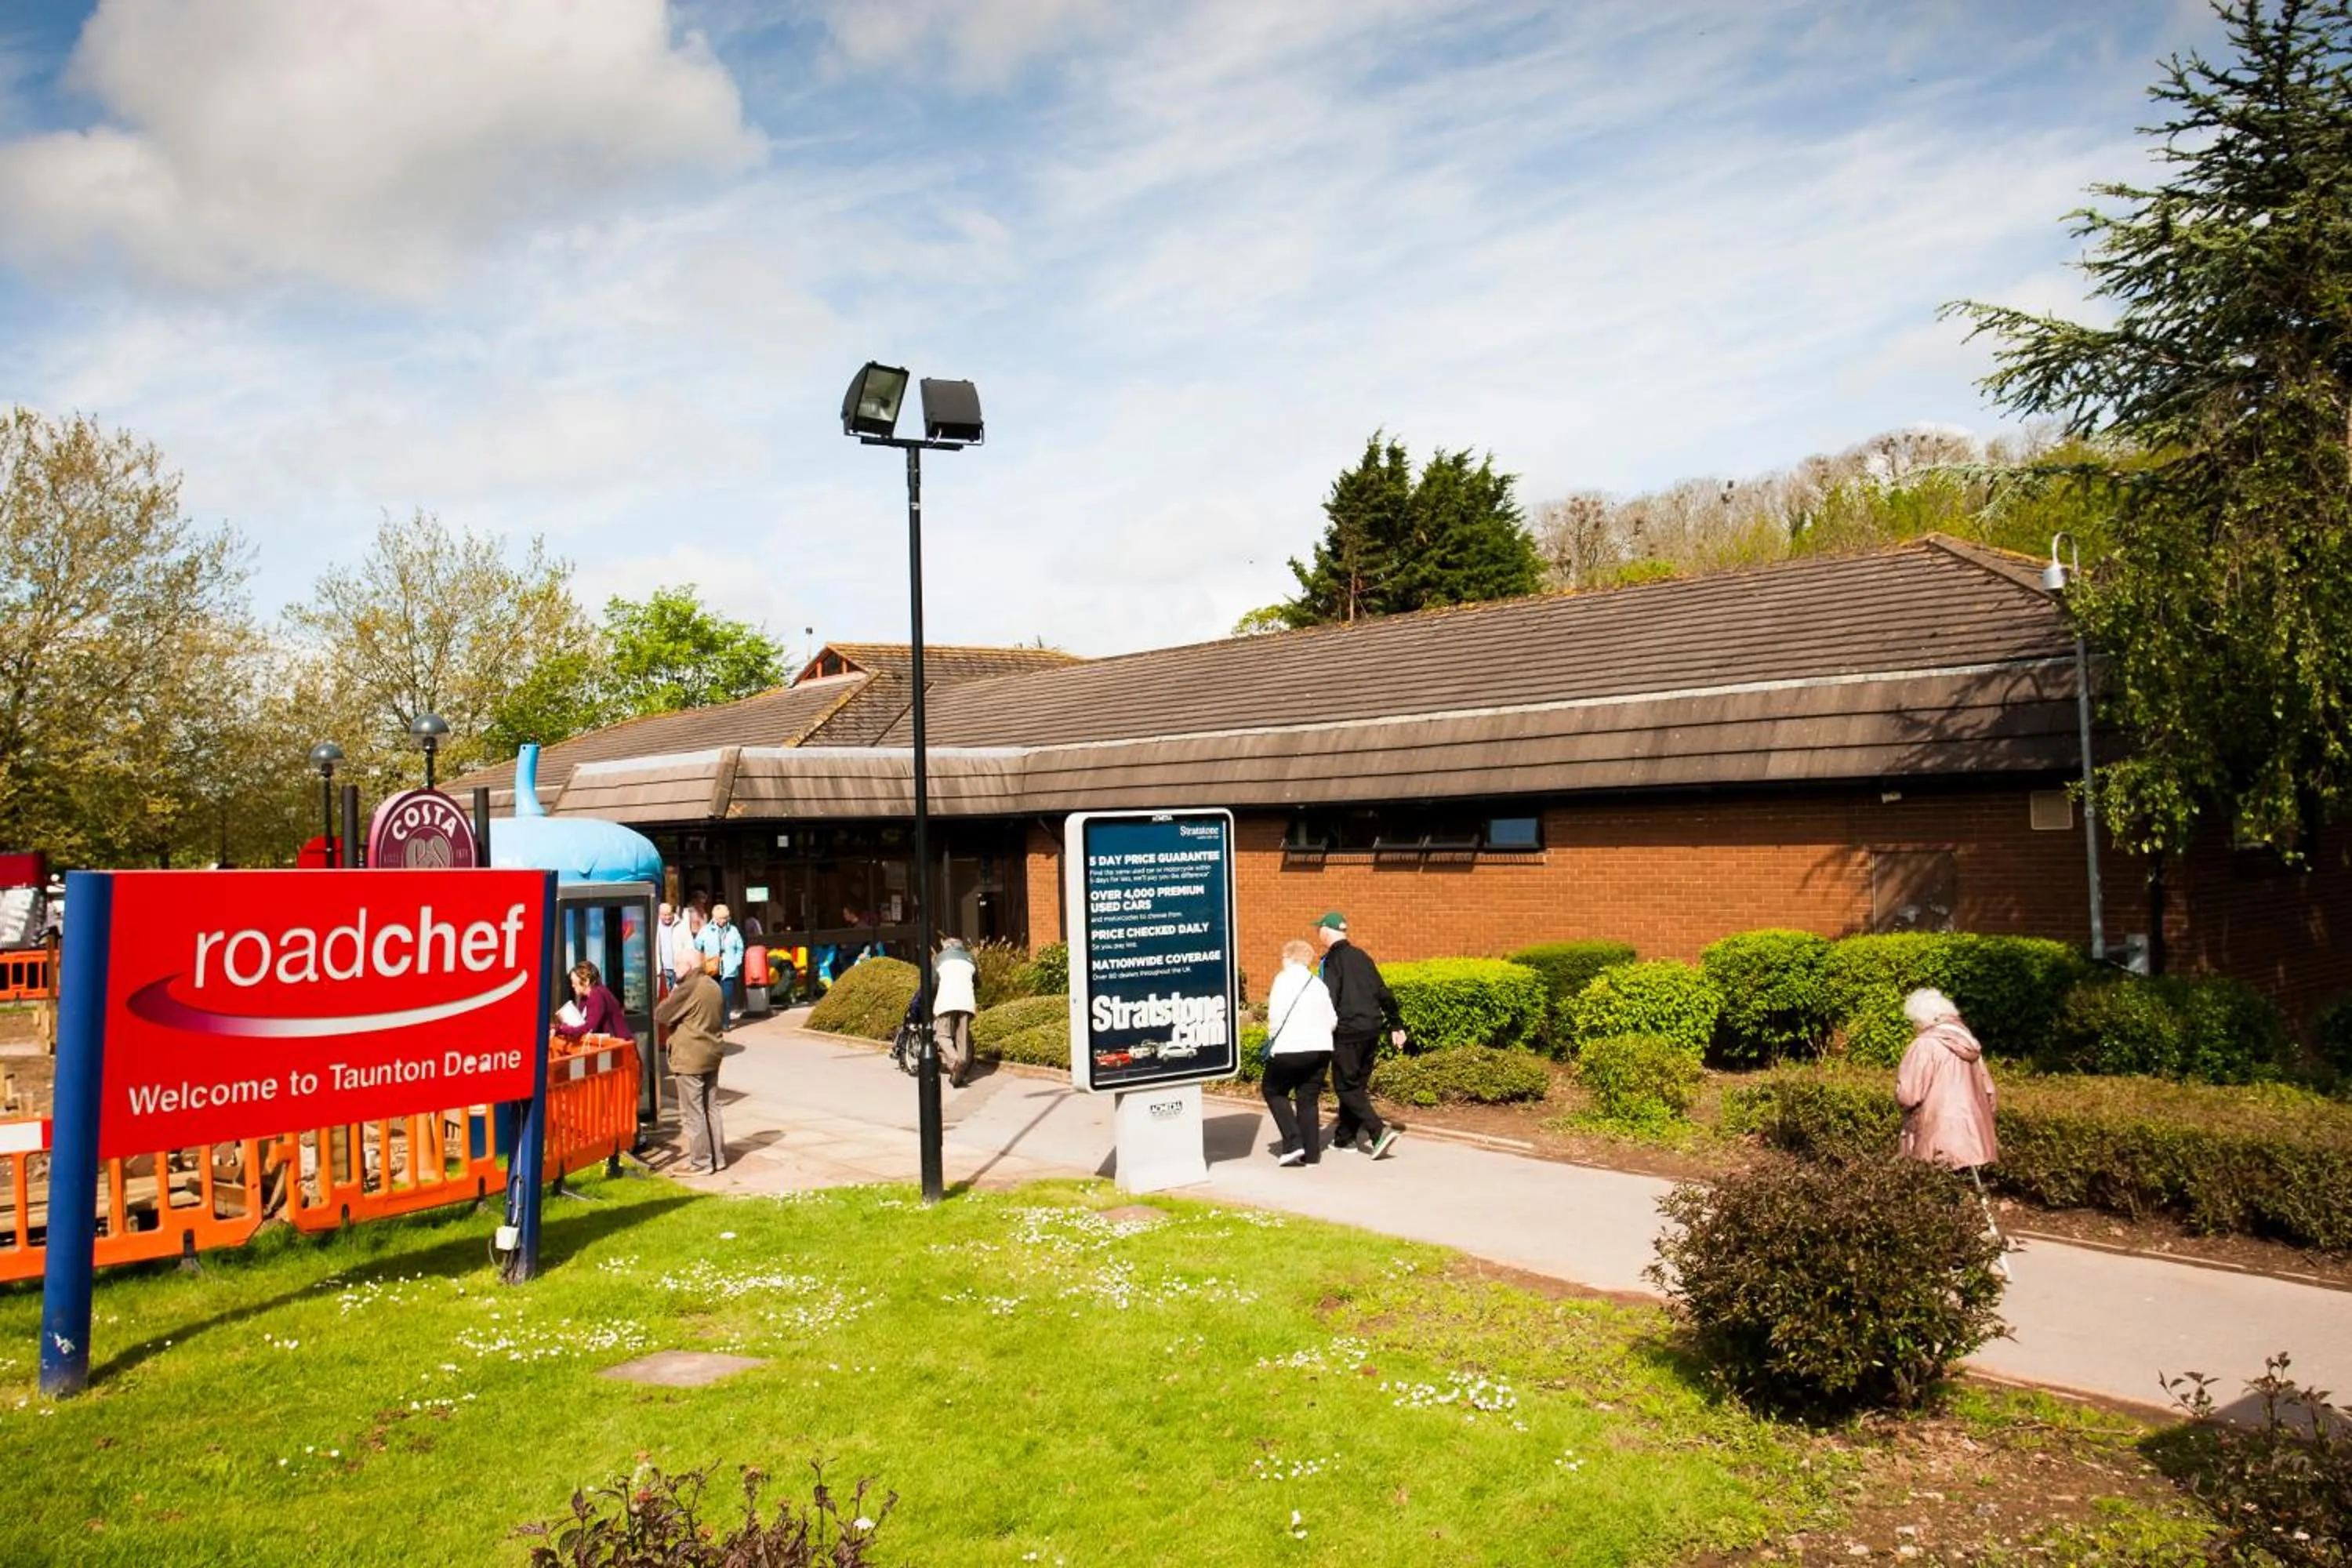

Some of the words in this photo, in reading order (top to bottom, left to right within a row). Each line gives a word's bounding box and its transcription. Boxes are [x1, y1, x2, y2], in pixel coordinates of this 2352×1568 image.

[393, 803, 457, 840] COSTA
[1089, 856, 1098, 866] 5
[1099, 855, 1123, 866] DAY
[1123, 852, 1156, 865] PRICE
[1157, 851, 1221, 863] GUARANTEE
[1091, 888, 1122, 901] OVER
[1123, 887, 1156, 902] 4,000
[1157, 884, 1205, 897] PREMIUM
[1091, 902, 1122, 913] USED
[1123, 900, 1152, 911] CARS
[1091, 927, 1125, 941] PRICE
[1126, 924, 1176, 938] CHECKED
[1178, 922, 1210, 935] DAILY
[194, 903, 525, 988] roadchef
[1091, 955, 1163, 971] NATIONWIDE
[1166, 950, 1221, 965] COVERAGE
[1091, 992, 1226, 1033] Stratstone
[128, 1077, 278, 1116] Welcome
[289, 1070, 318, 1096] to
[329, 1058, 435, 1091] Taunton
[444, 1049, 522, 1076] Deane
